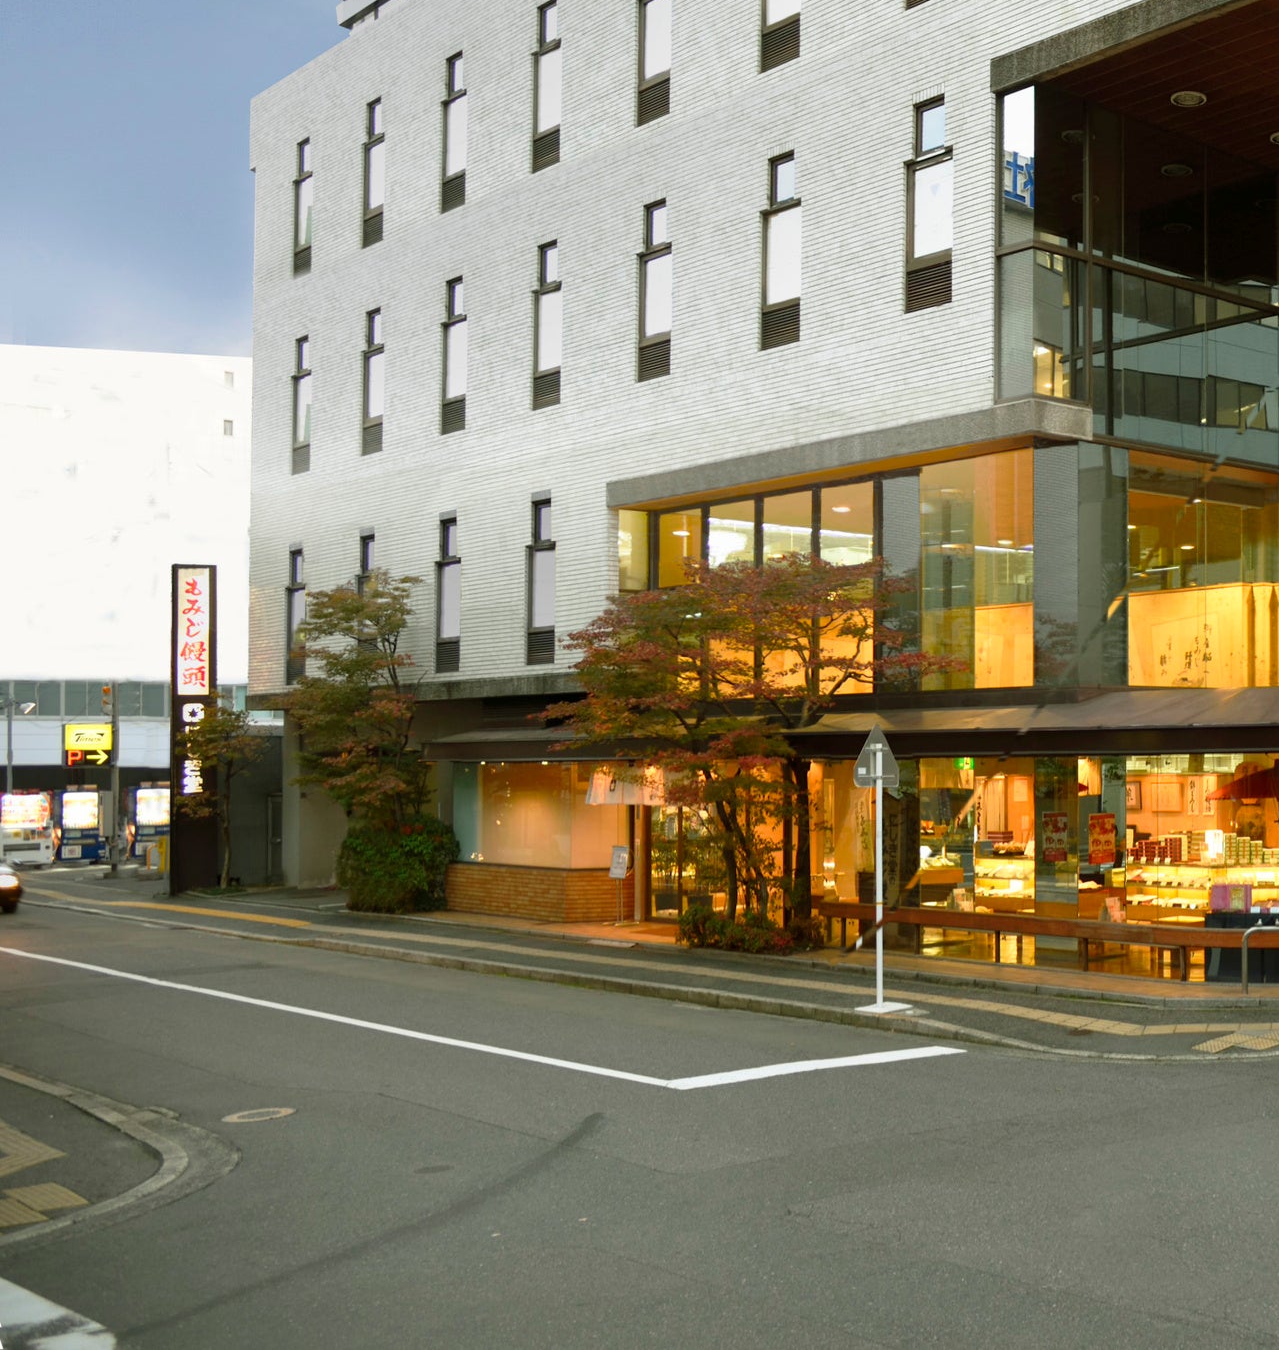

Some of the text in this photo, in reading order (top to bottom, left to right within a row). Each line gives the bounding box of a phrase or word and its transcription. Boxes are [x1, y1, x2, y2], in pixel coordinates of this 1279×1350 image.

[180, 578, 207, 688] もみじ饅頭
[67, 749, 84, 766] P
